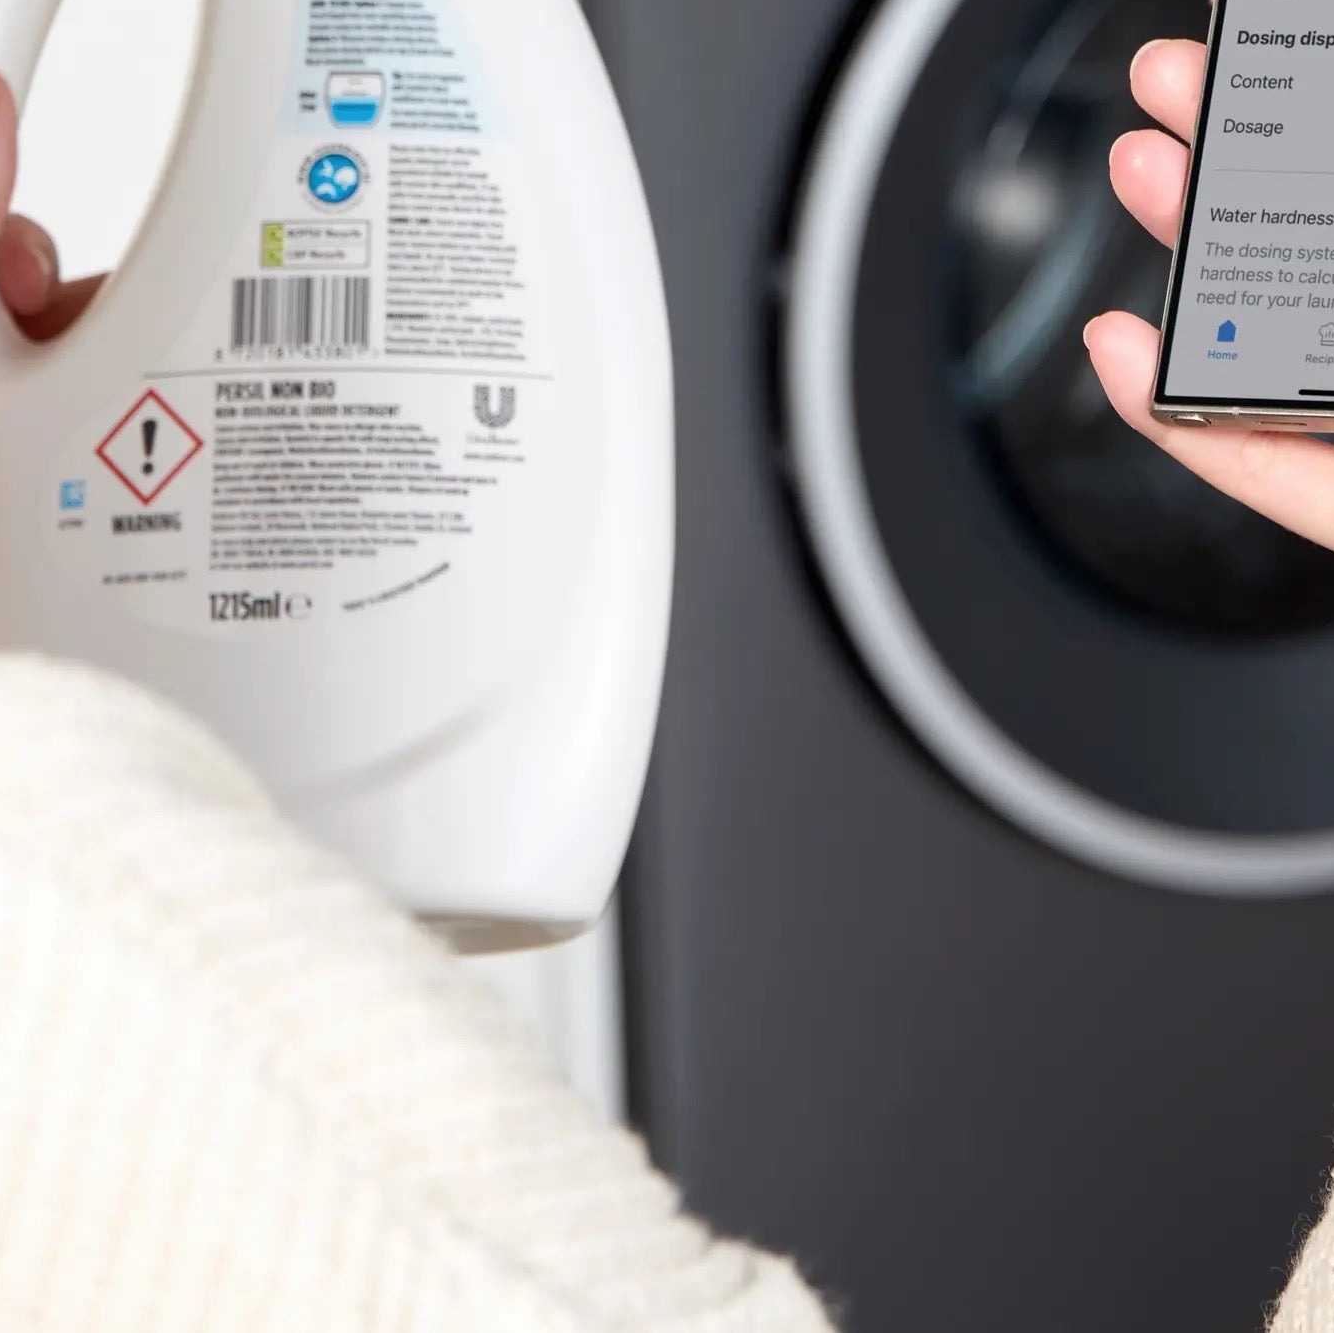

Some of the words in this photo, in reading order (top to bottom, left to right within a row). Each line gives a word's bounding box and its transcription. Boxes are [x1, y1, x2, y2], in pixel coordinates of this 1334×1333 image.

[1237, 30, 1295, 48] Dosing
[1231, 74, 1294, 89] Content
[1223, 119, 1283, 137] Dosage
[1211, 208, 1257, 223] Water
[1261, 209, 1334, 225] hardness
[1205, 242, 1234, 257] The
[1239, 243, 1291, 262] dosing
[1200, 266, 1273, 282] hardness
[1278, 269, 1294, 283] to
[1197, 290, 1237, 305] need
[1241, 291, 1263, 306] for
[1267, 295, 1303, 309] your
[1208, 350, 1238, 360] Home
[216, 381, 264, 402] PERSIL
[271, 381, 305, 400] NON
[310, 381, 335, 400] BIO
[112, 512, 180, 534] WARNING
[210, 592, 280, 621] 1215ml
